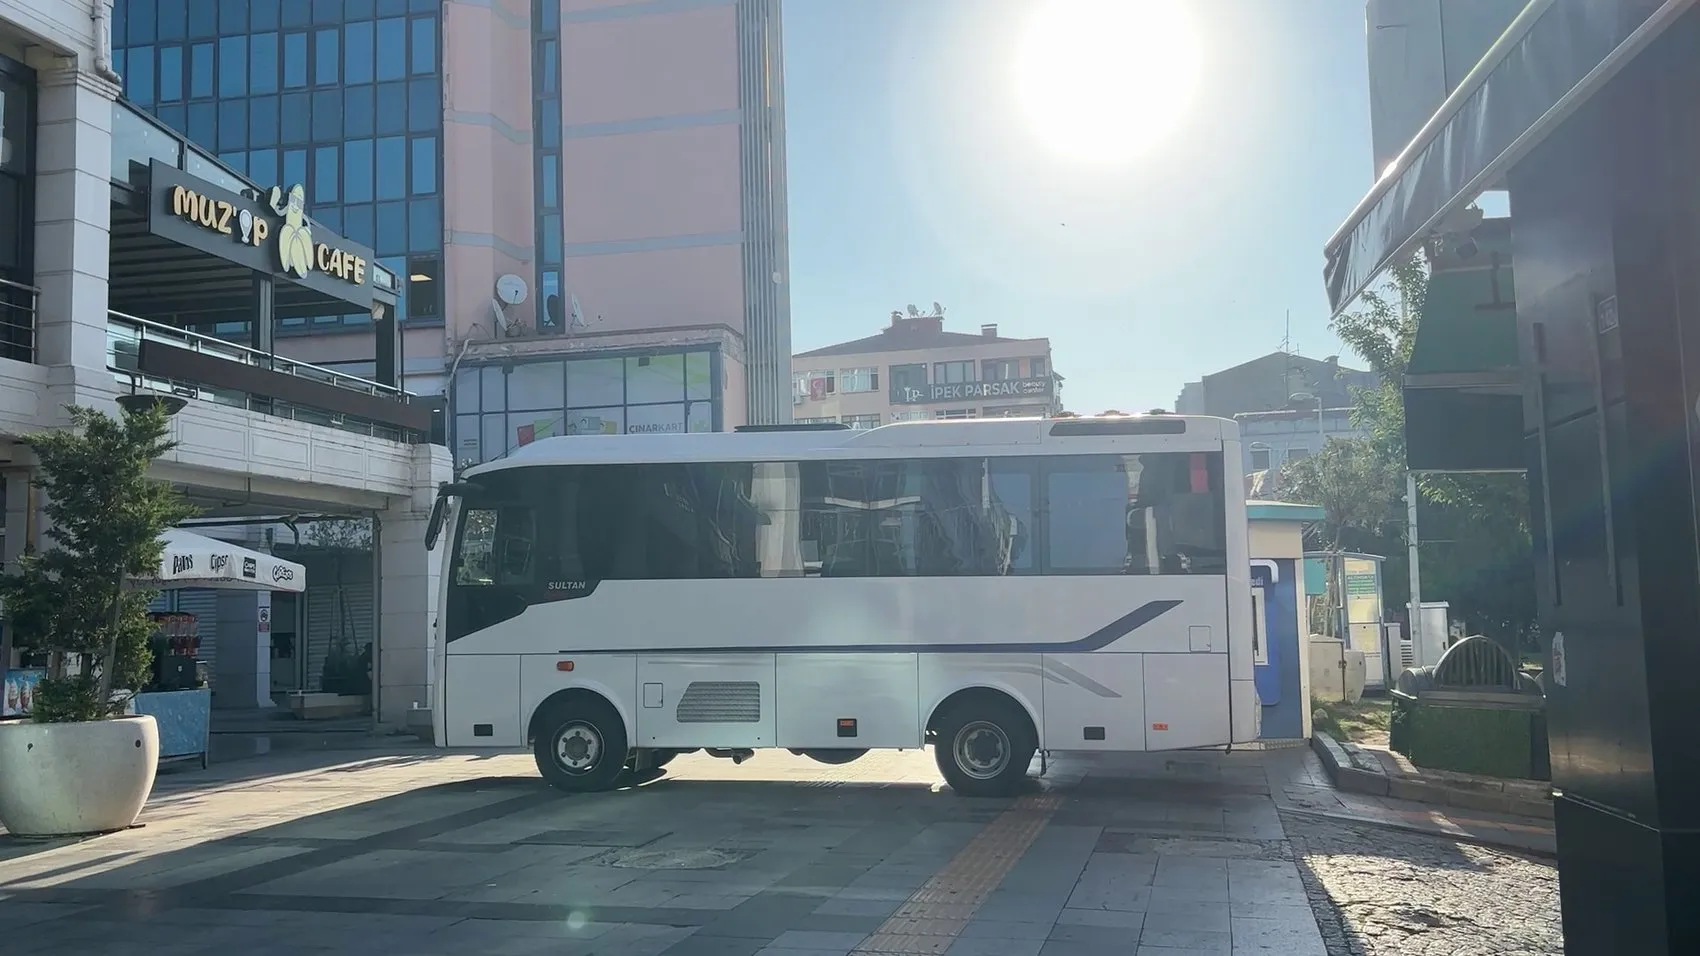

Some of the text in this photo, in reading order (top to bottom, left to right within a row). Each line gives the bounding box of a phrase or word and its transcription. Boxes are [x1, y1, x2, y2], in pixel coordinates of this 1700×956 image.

[317, 243, 366, 285] CAFE
[930, 381, 1019, 399] İPEK PARSAK
[629, 422, 683, 434] ÇINARKART
[548, 581, 586, 590] SULTAN
